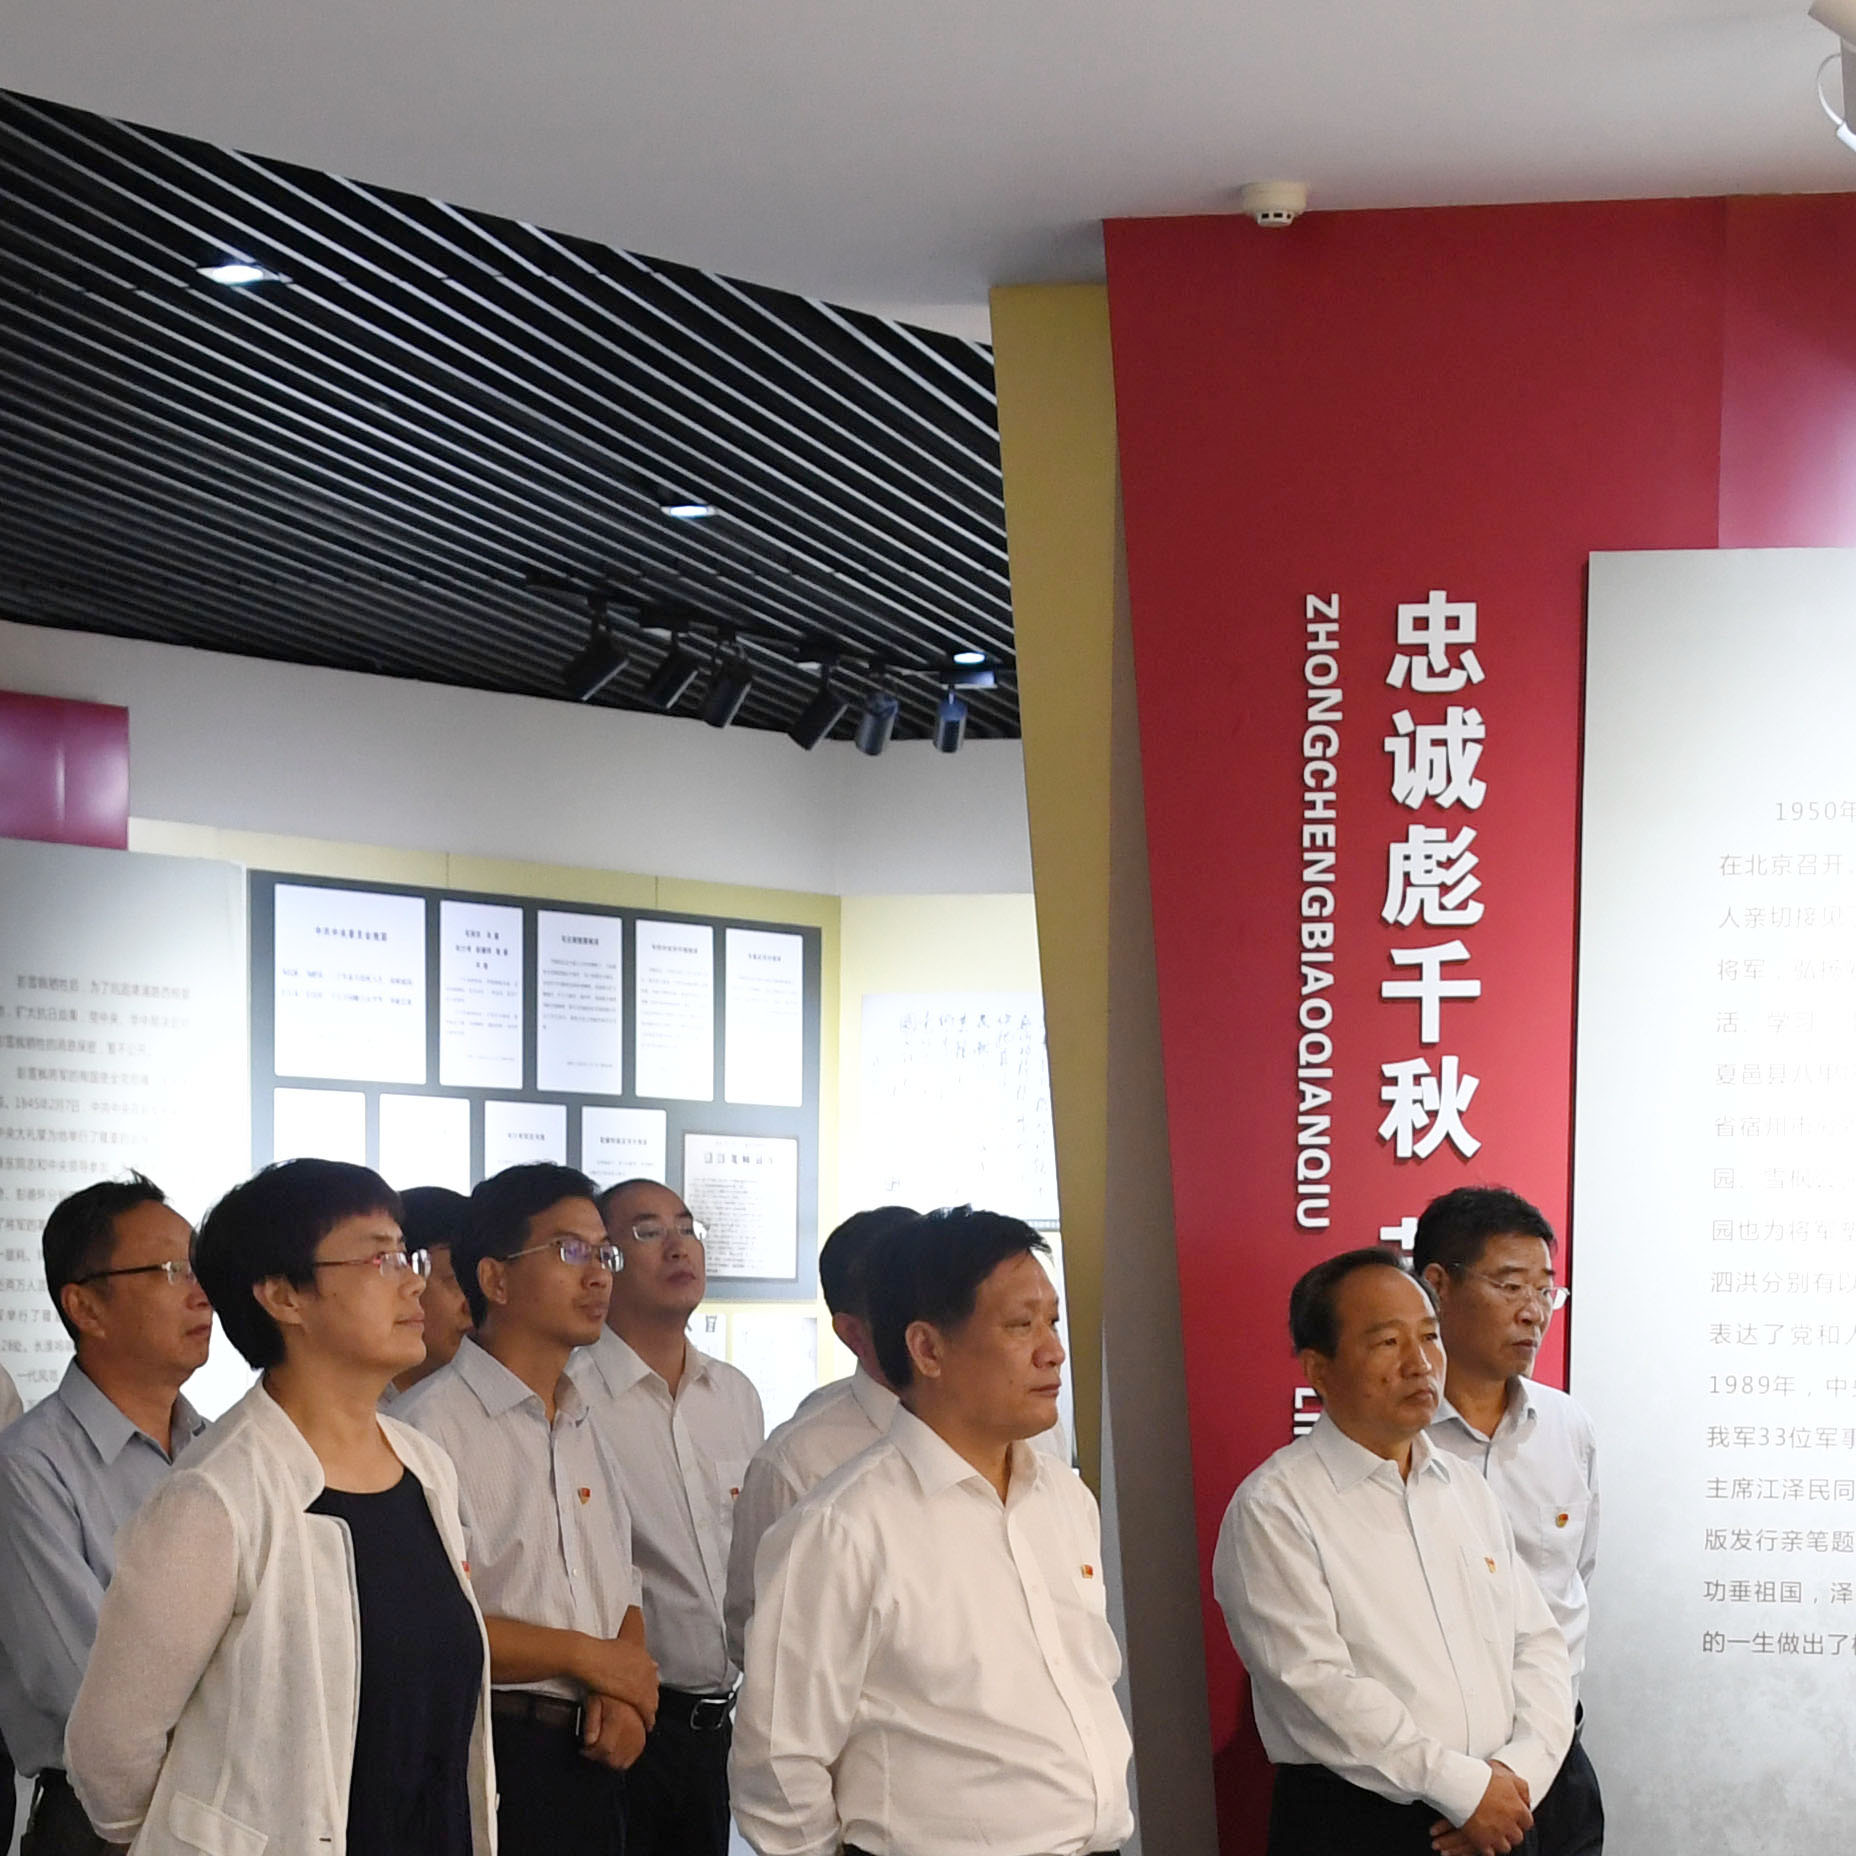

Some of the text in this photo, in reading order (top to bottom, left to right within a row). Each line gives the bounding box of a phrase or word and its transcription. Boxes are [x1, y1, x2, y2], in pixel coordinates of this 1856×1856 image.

[1296, 594, 1343, 1228] ZHONGCHENGBIAOQIANQIU
[1380, 590, 1486, 1160] 忠诚彪千秋
